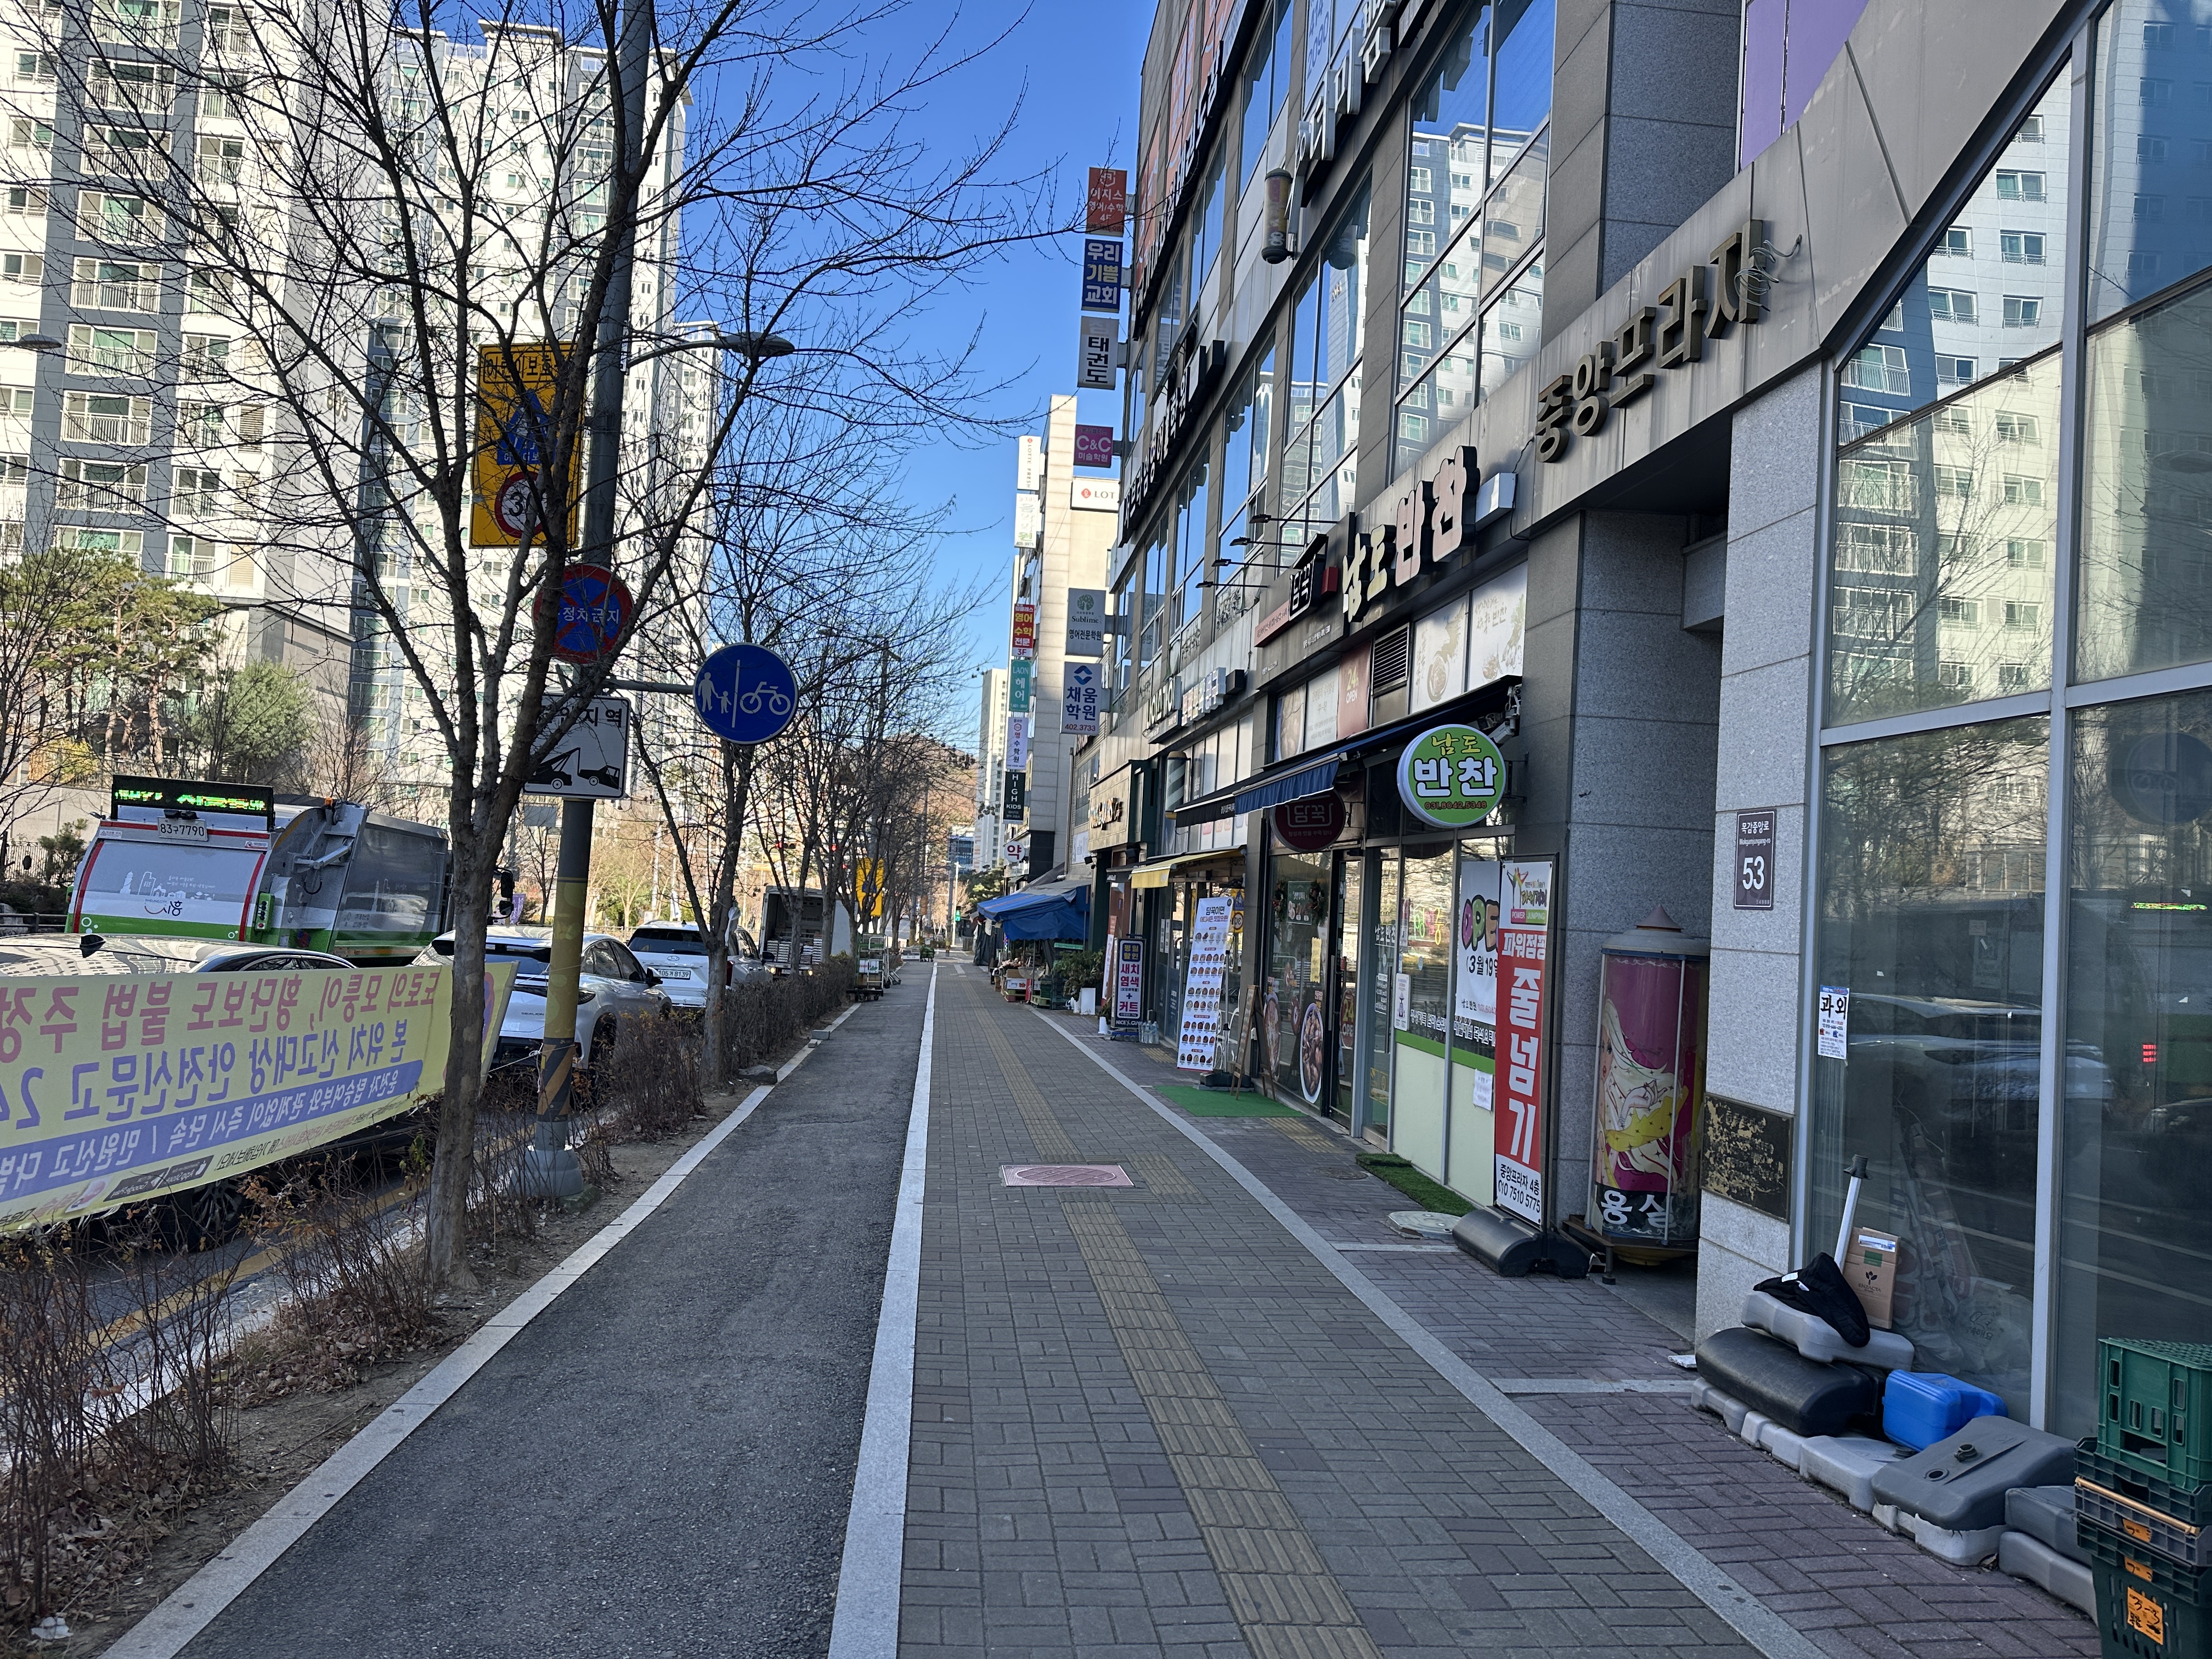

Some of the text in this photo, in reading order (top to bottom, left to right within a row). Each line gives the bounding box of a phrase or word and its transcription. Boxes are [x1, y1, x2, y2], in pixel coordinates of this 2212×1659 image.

[1090, 188, 1124, 201] 이지스
[1087, 242, 1120, 262] 우리
[1086, 264, 1119, 283] 기쁨
[1085, 285, 1118, 304] 교회
[1536, 219, 1765, 463] 중앙프라자
[1086, 336, 1109, 383] 태권도
[1076, 435, 1111, 453] C&C
[1078, 453, 1108, 462] 미술학원
[1342, 445, 1466, 623] 남도 반찬
[558, 606, 619, 624] 정차금지
[1015, 613, 1032, 623] 영어
[1071, 616, 1099, 624] Sublime
[1014, 627, 1032, 636] 수학
[1069, 629, 1102, 641] 영어전문학원
[1014, 637, 1030, 646] 전문
[1013, 666, 1029, 674] LAON
[1015, 678, 1025, 701] 헤어
[1066, 687, 1098, 703] 채움
[1346, 689, 1358, 703] OPEN
[1065, 703, 1096, 721] 학원
[1146, 677, 1175, 729] 나이스가이
[1431, 733, 1481, 757] 남도
[1413, 757, 1498, 797] 반찬
[1424, 801, 1487, 810] 031.8042.5348
[160, 824, 205, 837] 83구7790
[1741, 821, 1770, 834] 목감중앙로
[1007, 845, 1022, 860] 약
[1742, 856, 1765, 890] 53
[1462, 895, 1498, 952] OPE
[1527, 912, 1545, 920] JUMPING
[1502, 933, 1546, 960] 파워점핑
[1121, 964, 1139, 974] 새치
[1121, 976, 1139, 987] 염색
[1119, 1001, 1138, 1012] 커트
[1344, 998, 1355, 1023] 24
[1820, 995, 1847, 1020] 과외
[1342, 1024, 1353, 1036] OPE
[1508, 967, 1542, 1165] 줄넘기
[1500, 1164, 1539, 1196] 중앙프라자 4층
[1498, 1180, 1541, 1214] 010 7510 5775
[1858, 1283, 1881, 1293] ENZACTA
